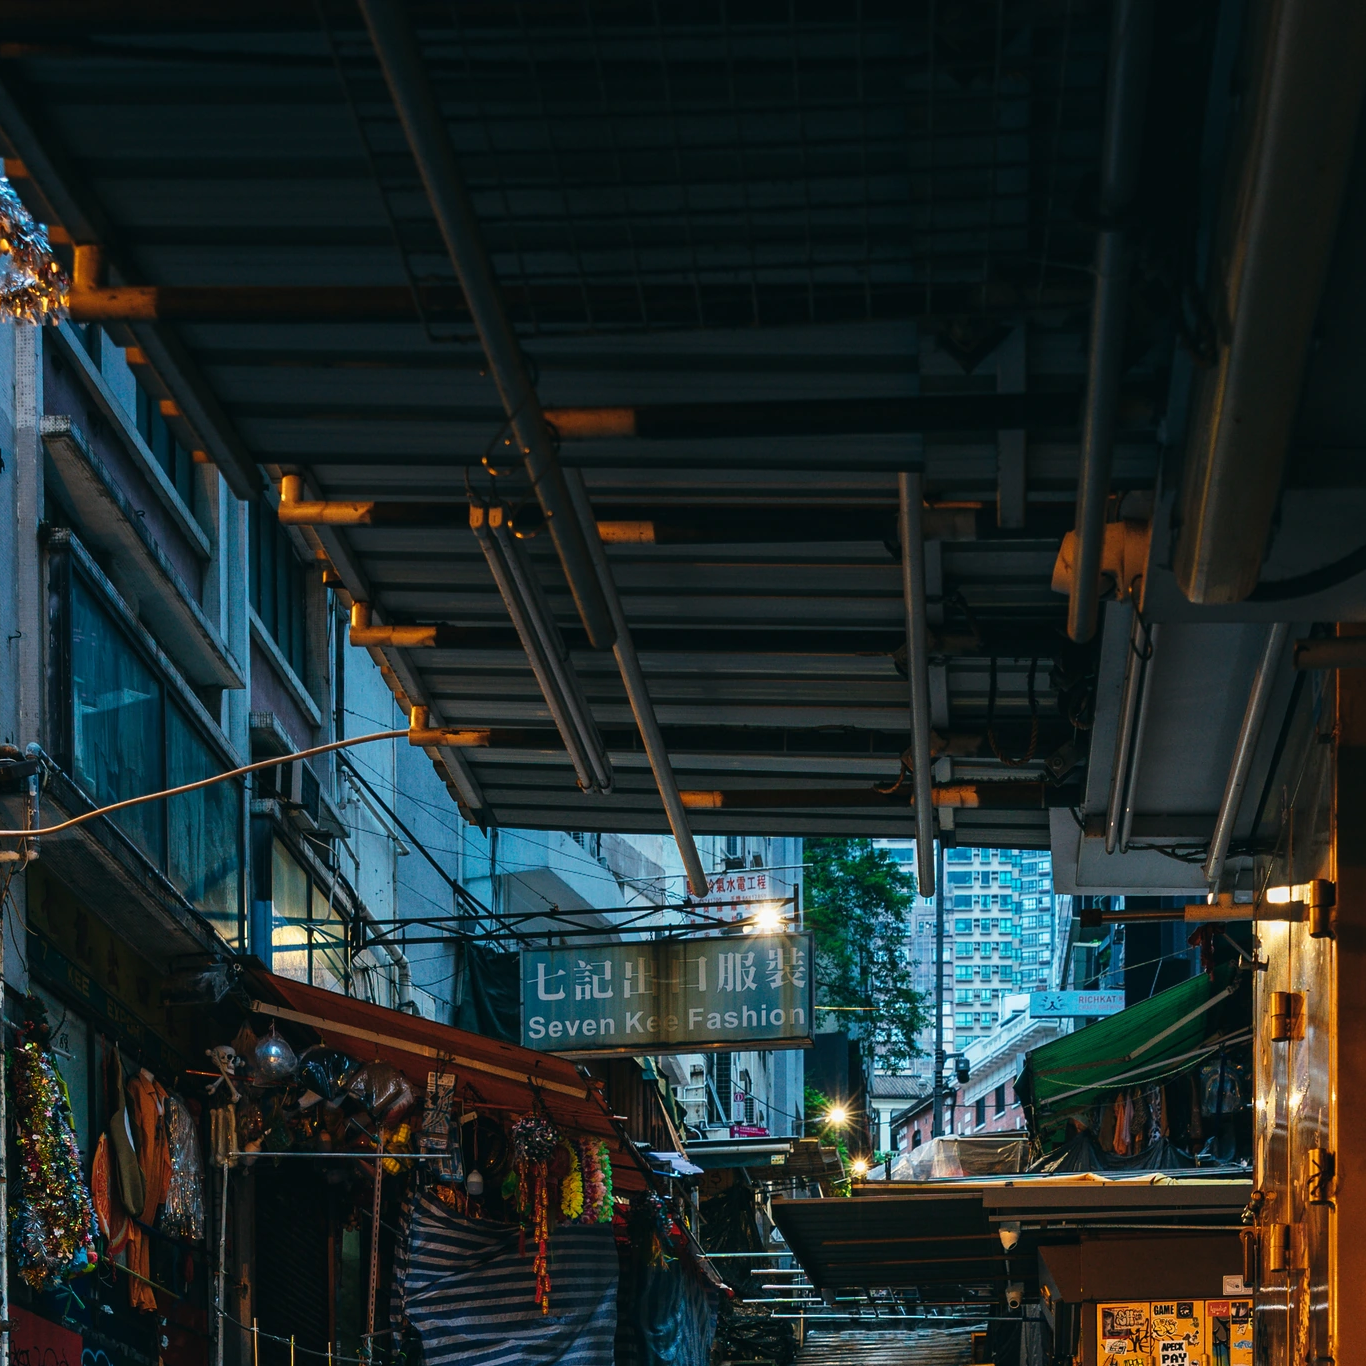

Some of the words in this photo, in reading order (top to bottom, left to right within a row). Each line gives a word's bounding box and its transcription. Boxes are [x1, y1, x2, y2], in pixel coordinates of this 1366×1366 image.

[67, 962, 90, 998] KEE
[527, 948, 806, 1001] 七記出口服裝
[1078, 995, 1117, 1004] RICHKAT
[528, 1015, 615, 1039] Seven
[626, 1011, 679, 1034] Kee
[689, 1004, 805, 1030] Fashion
[1154, 1304, 1174, 1315] GAME
[1161, 1353, 1187, 1364] PAY
